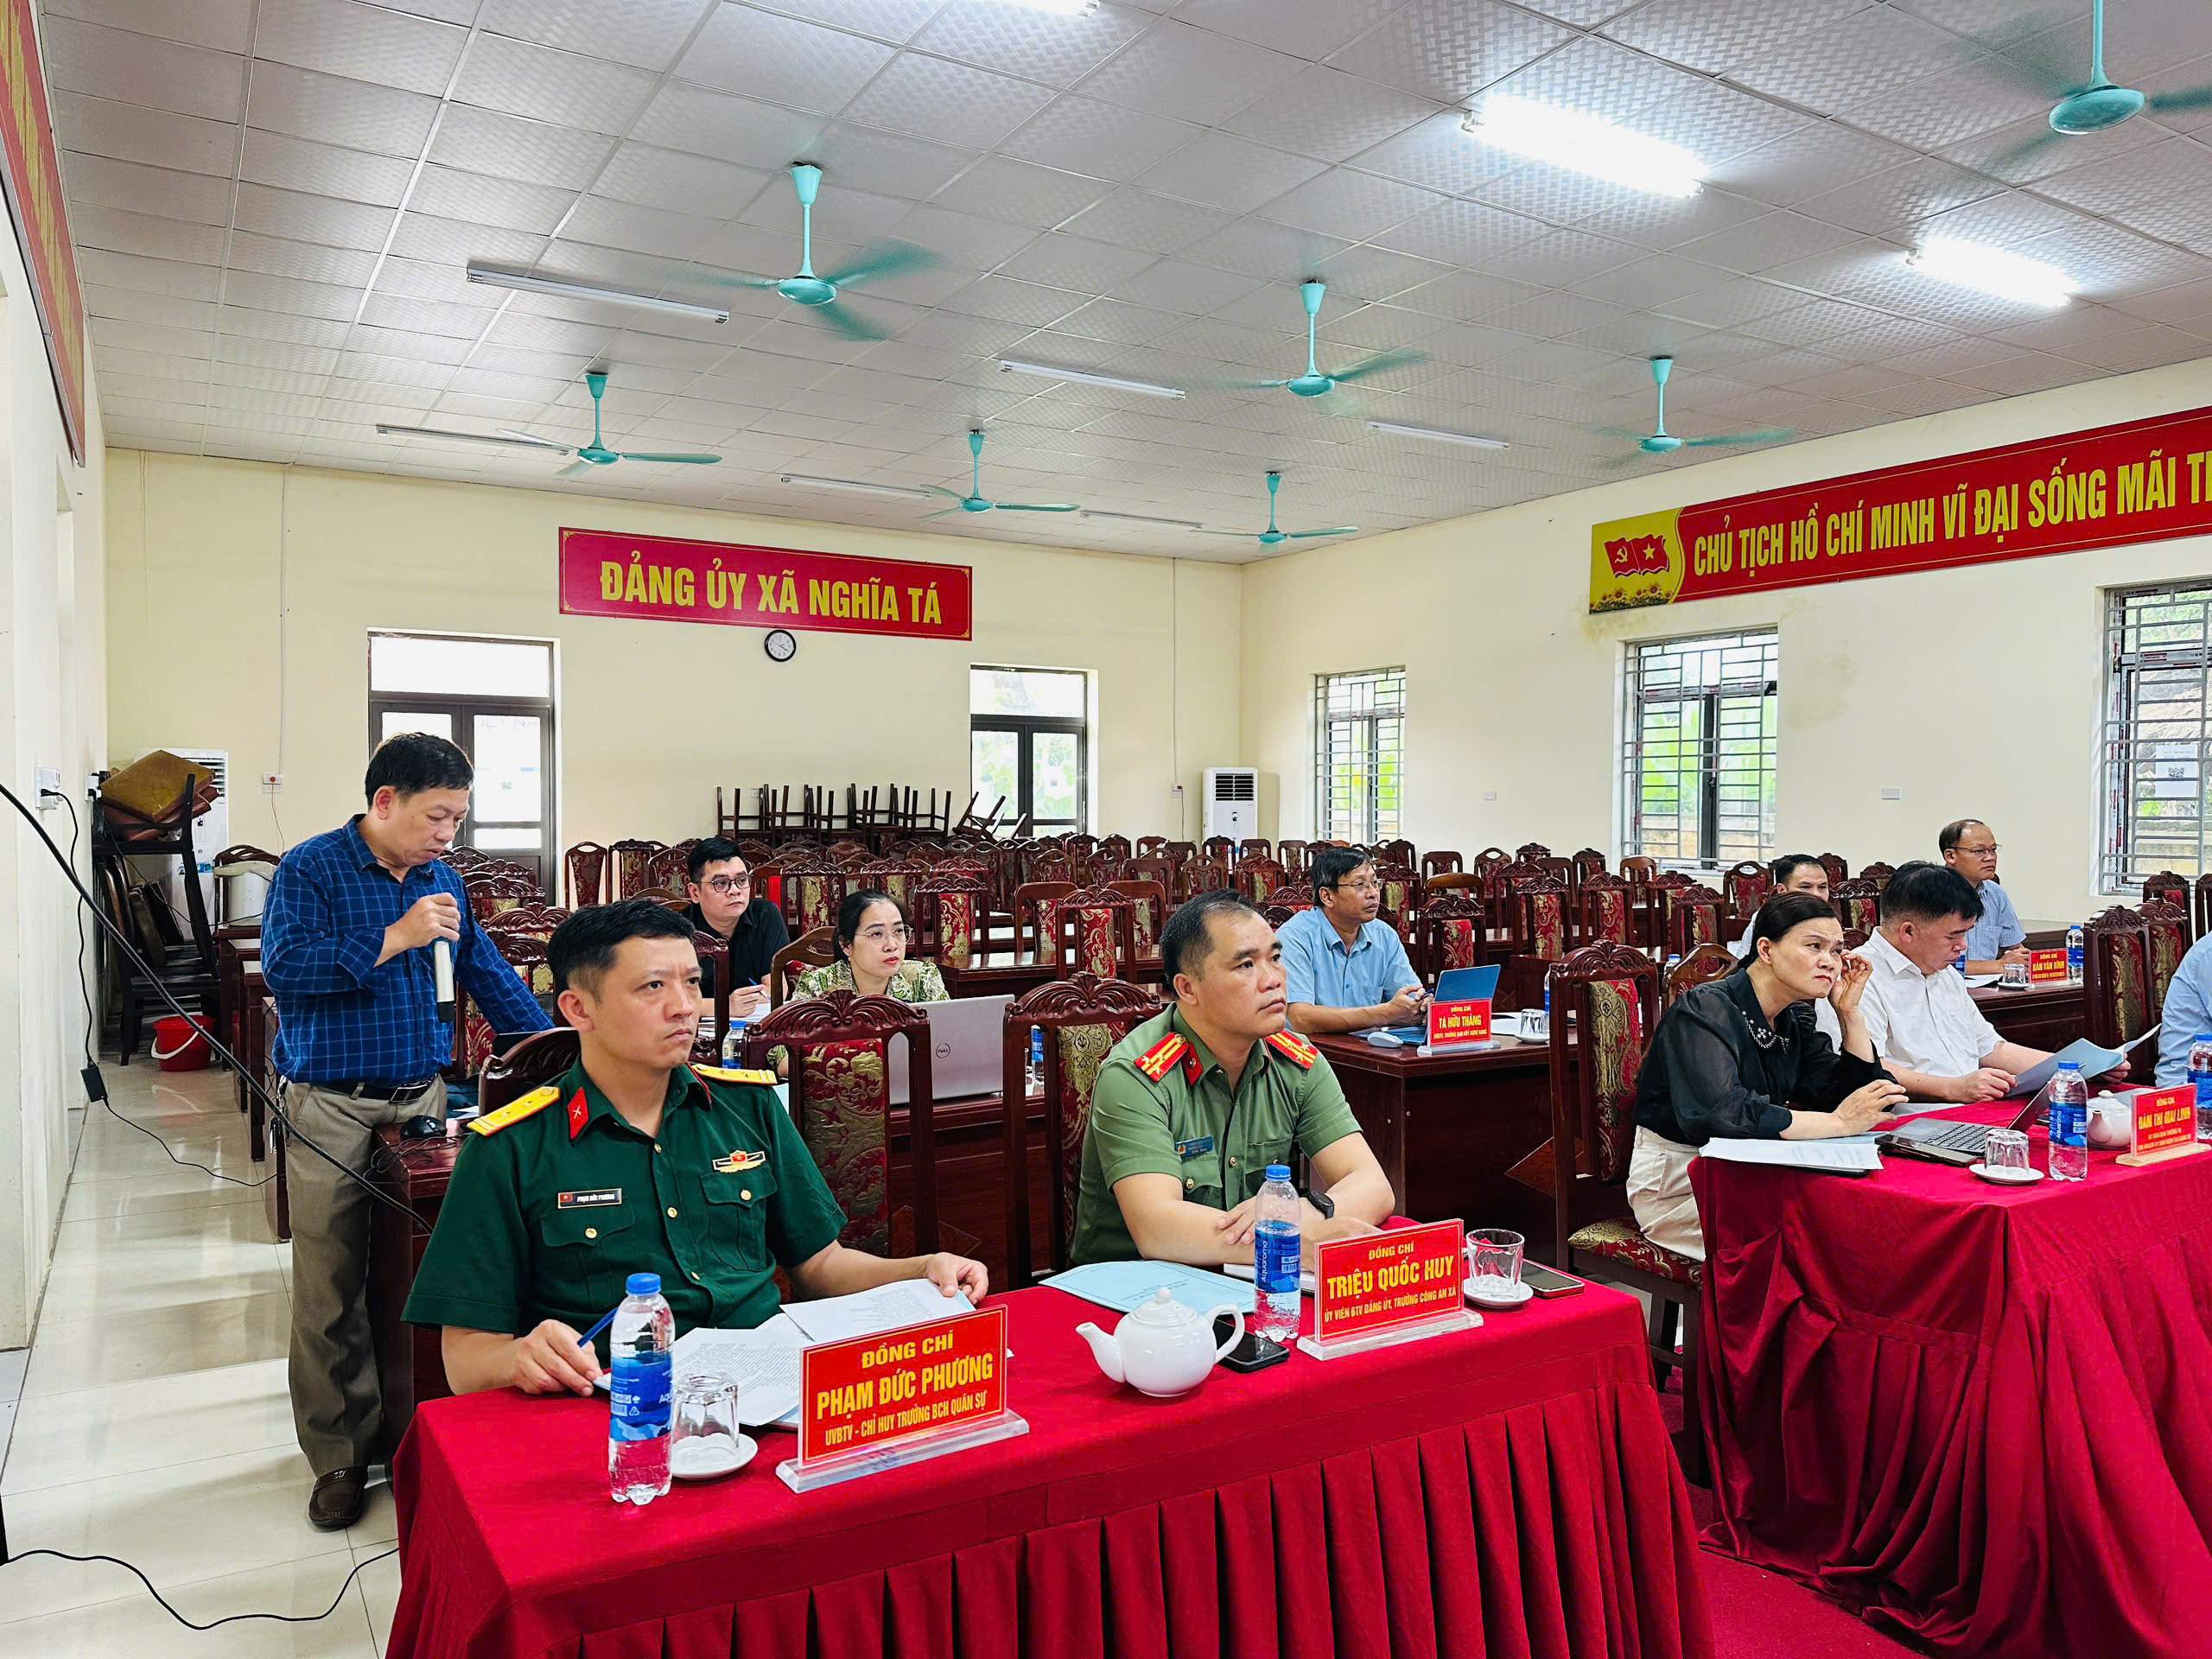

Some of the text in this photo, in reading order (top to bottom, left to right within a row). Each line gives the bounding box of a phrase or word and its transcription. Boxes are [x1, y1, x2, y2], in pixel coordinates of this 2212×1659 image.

[1694, 514, 1732, 576] CHỦ
[1738, 524, 1783, 579] TỊCH
[1790, 501, 1820, 563] HỒ
[1826, 499, 1863, 556] CHÍ
[1871, 497, 1935, 550] MINH
[1942, 483, 1967, 539] VĨ
[1974, 484, 2018, 544] ĐẠI
[2029, 456, 2106, 524] SỐNG
[2117, 448, 2176, 515] MÃI
[600, 550, 942, 625] ĐẢNG ỦY XÃ NGHĨA TÁ
[1369, 1240, 1414, 1260] ĐỒNG CHÍ
[1327, 1255, 1454, 1300] TRIỆU QUỐC HUY
[1438, 1287, 1447, 1300] AN
[861, 1329, 954, 1369] ĐỒNG CHÍ
[817, 1352, 993, 1420] PHẠM ĐỨC PHƯƠNG
[825, 1425, 853, 1446] UVBTV
[861, 1413, 876, 1438] CHỈ
[878, 1416, 895, 1435] HUY
[932, 1401, 949, 1420] BCH
[950, 1394, 973, 1414] QUÂN
[975, 1389, 988, 1412] SỰ
